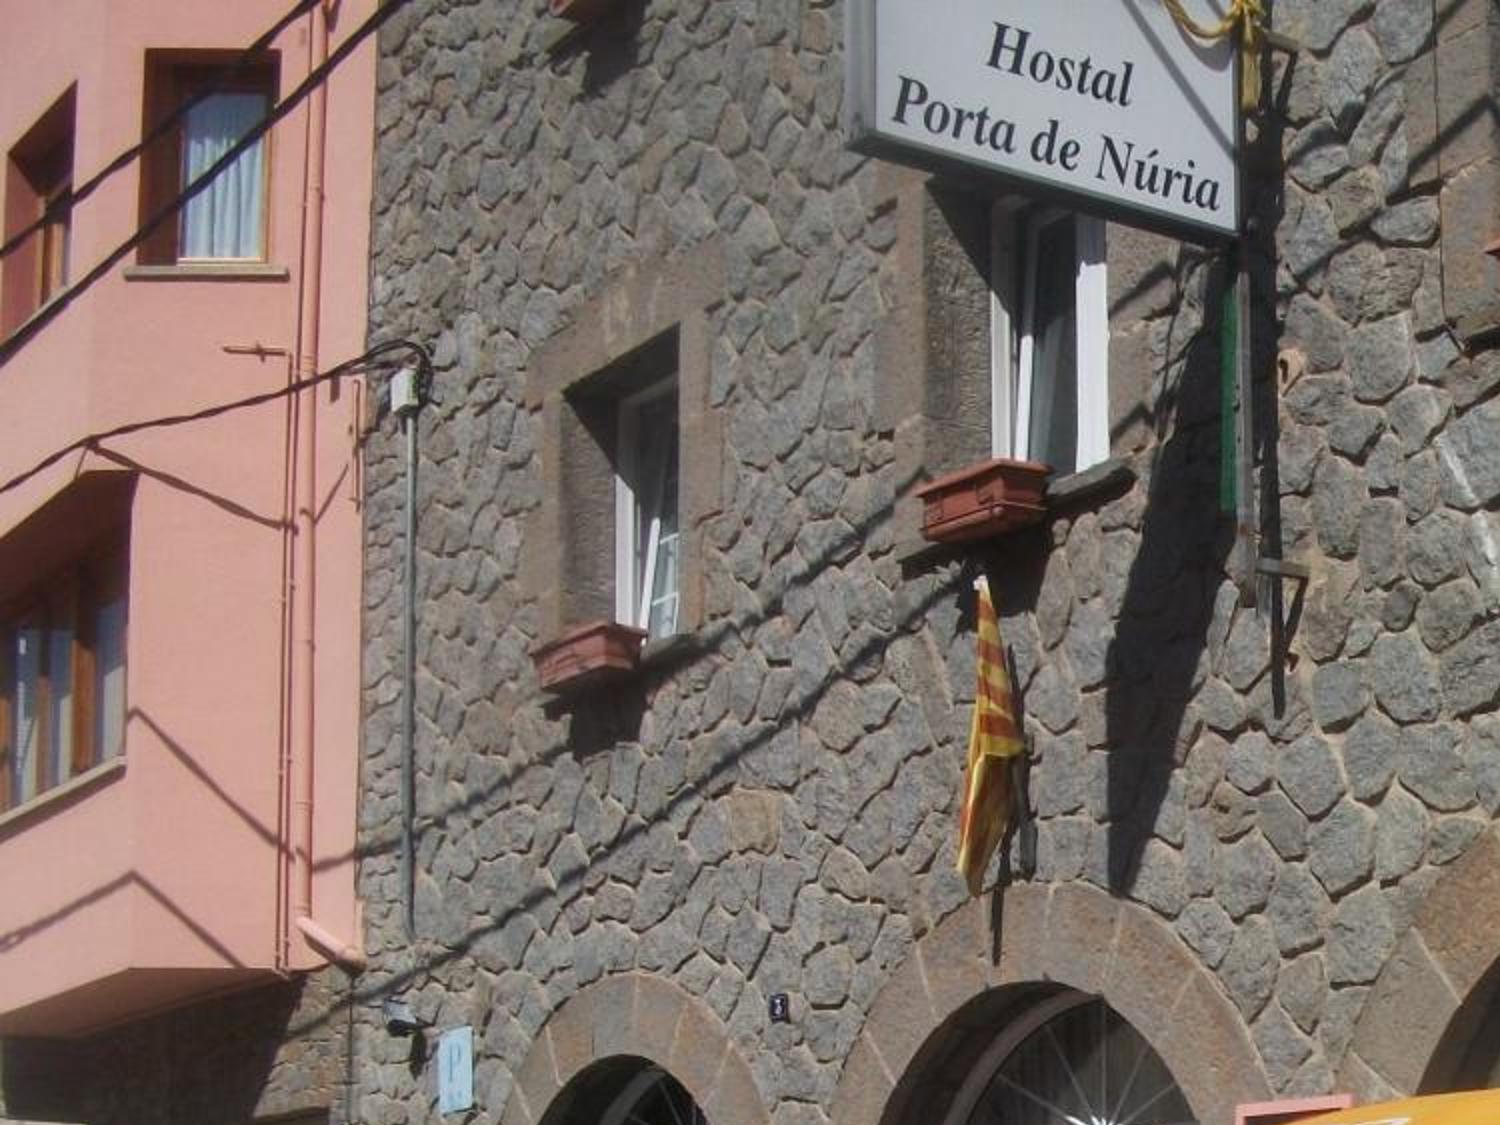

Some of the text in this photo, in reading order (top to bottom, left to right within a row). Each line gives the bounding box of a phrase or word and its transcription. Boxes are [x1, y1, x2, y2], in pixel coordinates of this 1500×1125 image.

[986, 21, 1134, 107] Hostal
[891, 75, 1220, 211] Porta de Núria
